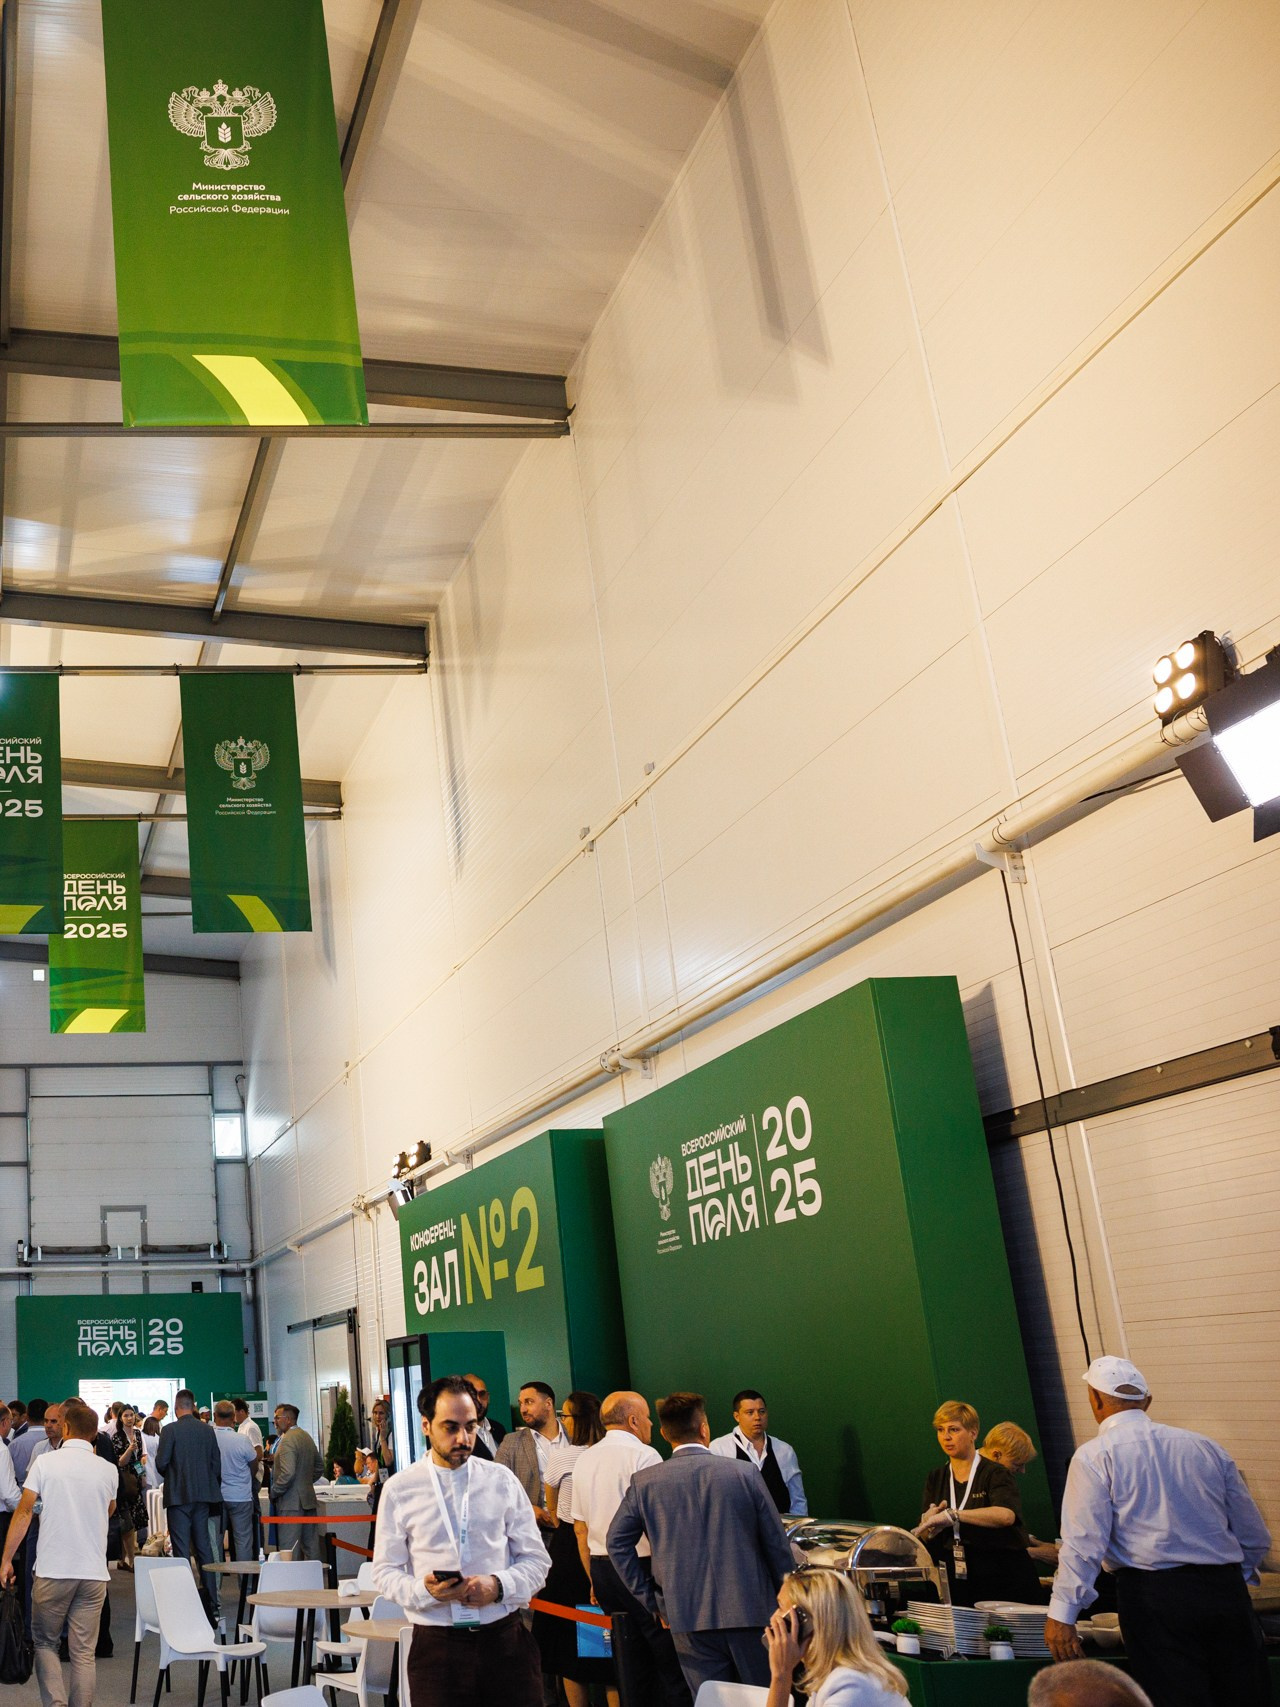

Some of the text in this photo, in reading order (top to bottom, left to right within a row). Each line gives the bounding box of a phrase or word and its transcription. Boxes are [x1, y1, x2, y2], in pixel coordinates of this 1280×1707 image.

[192, 182, 266, 192] Министерство
[232, 192, 281, 202] хозяйства
[170, 204, 290, 214] Российской Федерации
[64, 880, 126, 895] ДЕНЬ
[64, 896, 126, 911] ПОЛЯ
[64, 923, 128, 939] 2025
[681, 1114, 747, 1156] ВСЕРОССИЙСКИЙ
[762, 1096, 812, 1161] 20
[686, 1142, 752, 1201] ДЕНЬ
[770, 1158, 822, 1224] 25
[688, 1186, 760, 1246] ПОЛЯ
[410, 1218, 456, 1252] КОНФЕРЕНЦ-
[414, 1186, 545, 1316] ЗАЛ №2
[78, 1326, 136, 1340] ДЕНЬ
[148, 1318, 184, 1336] 20
[78, 1341, 137, 1356] ПОЛЯ
[149, 1337, 184, 1355] 25
